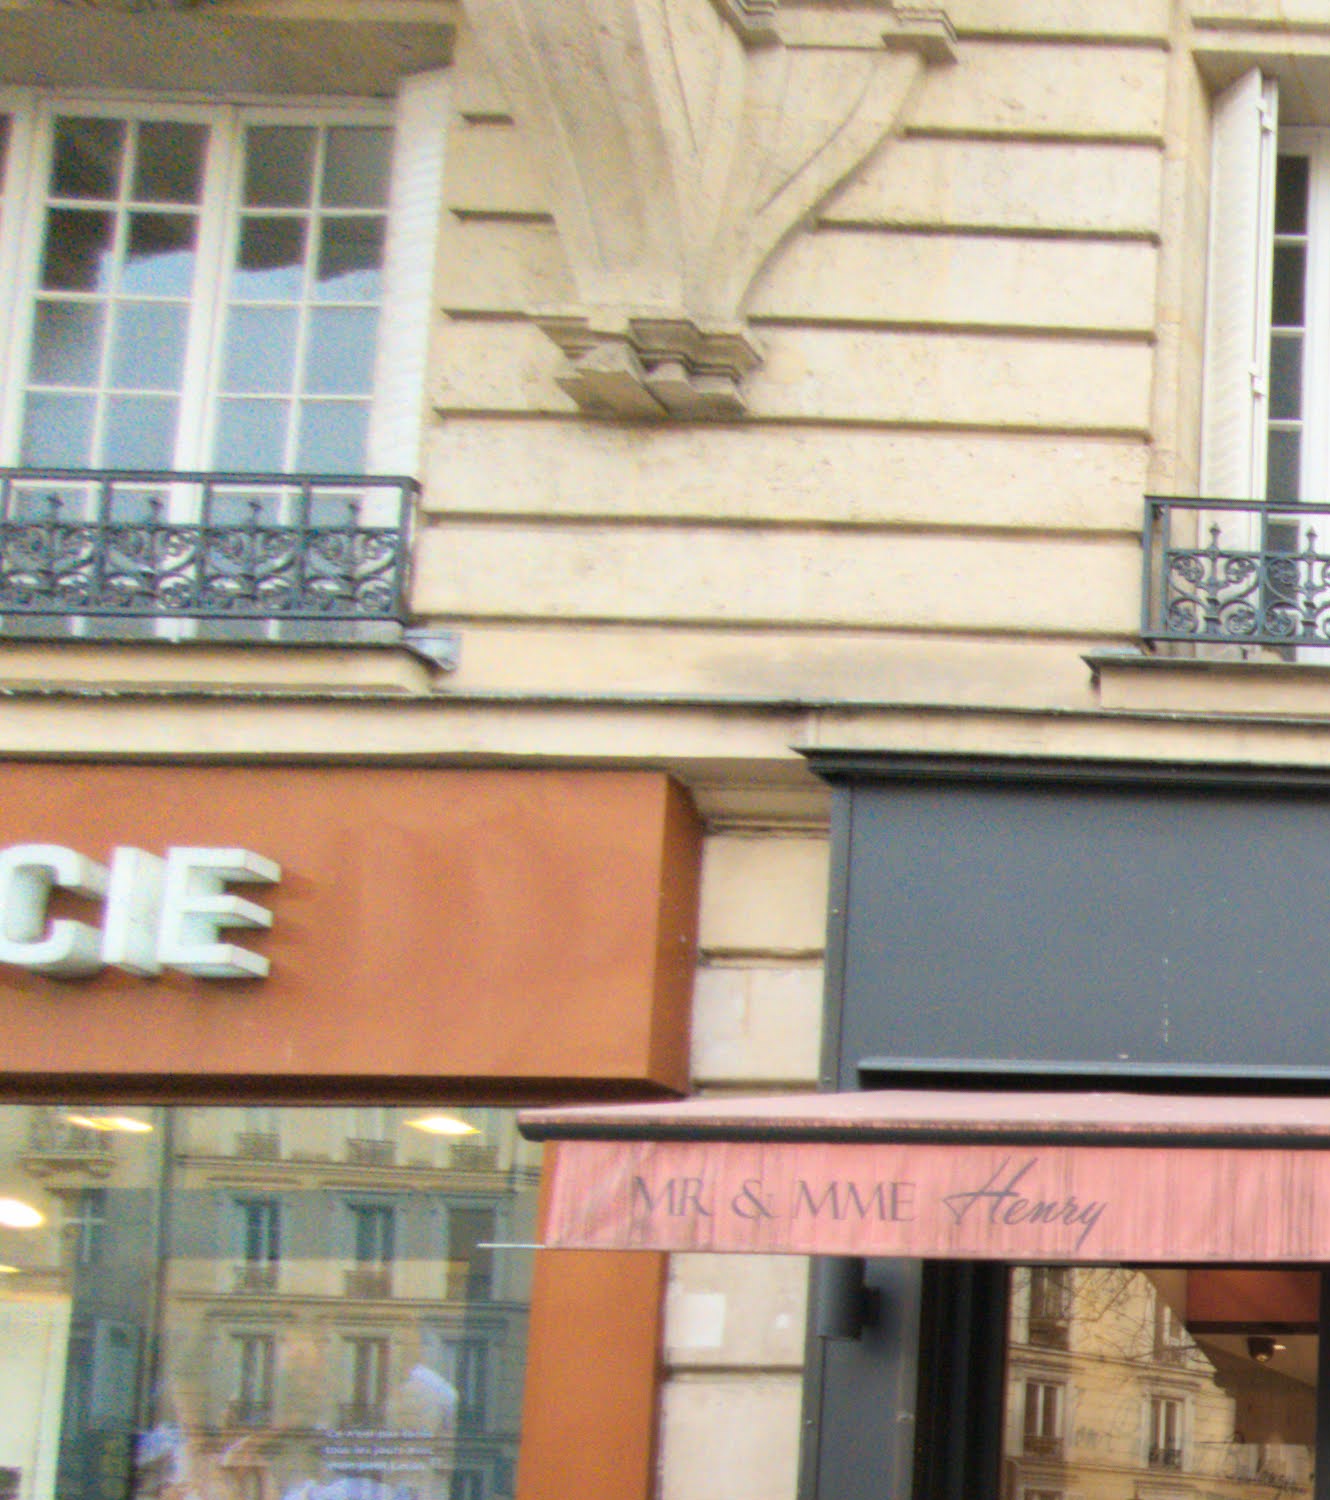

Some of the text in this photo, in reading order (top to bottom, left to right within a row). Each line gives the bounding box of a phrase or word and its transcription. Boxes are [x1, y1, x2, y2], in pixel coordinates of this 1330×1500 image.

[632, 1156, 1111, 1251] MR & MME Henry
